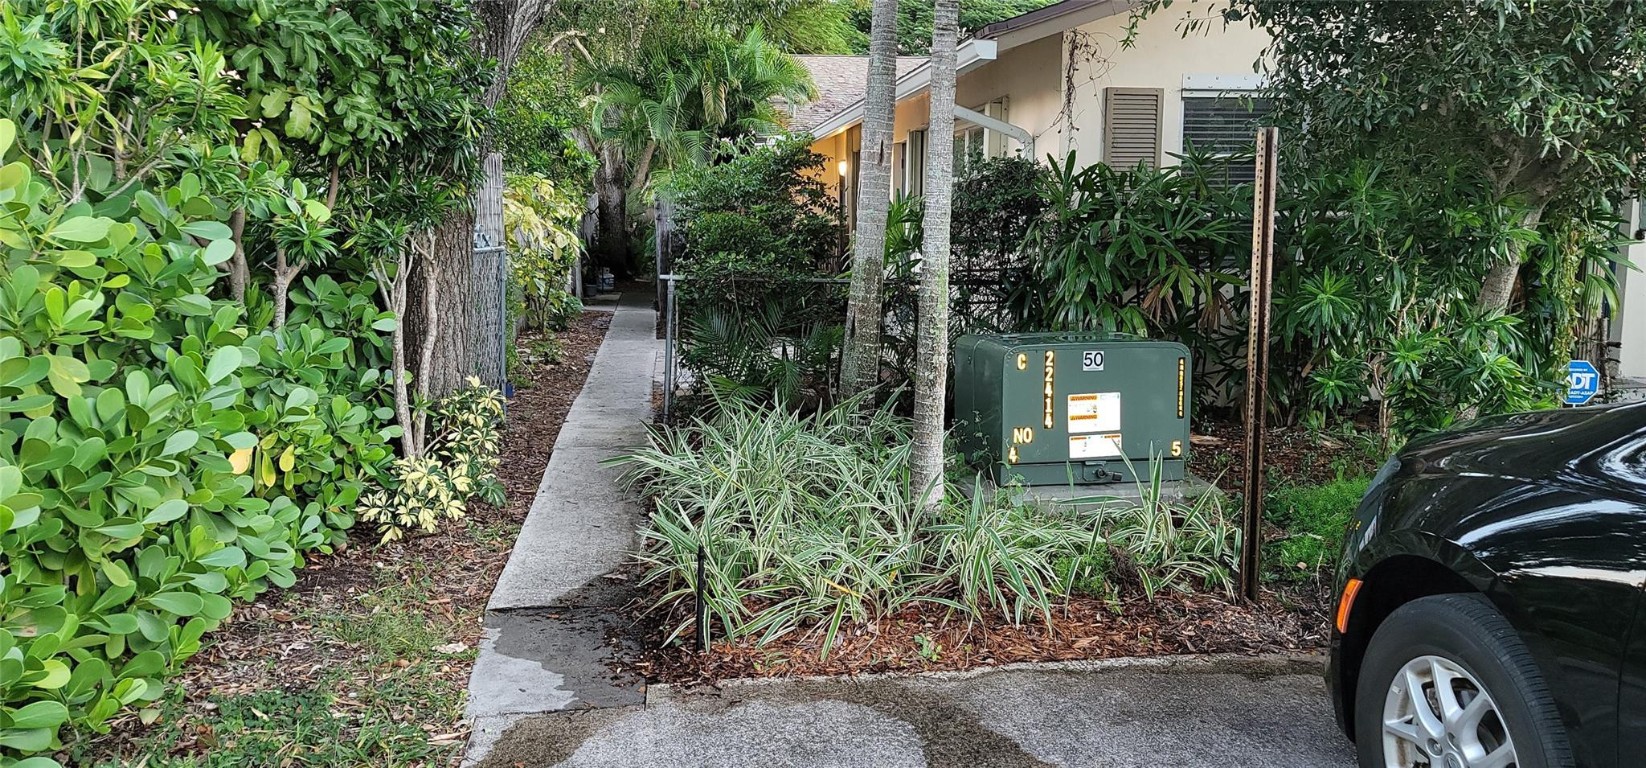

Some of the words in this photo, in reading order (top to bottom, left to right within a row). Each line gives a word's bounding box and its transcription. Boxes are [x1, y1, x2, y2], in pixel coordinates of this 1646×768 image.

[1017, 354, 1026, 369] C
[1083, 352, 1104, 367] 50
[1045, 351, 1054, 428] 22414
[1013, 427, 1032, 443] NO
[1009, 446, 1017, 462] 4
[1171, 441, 1181, 456] 5
